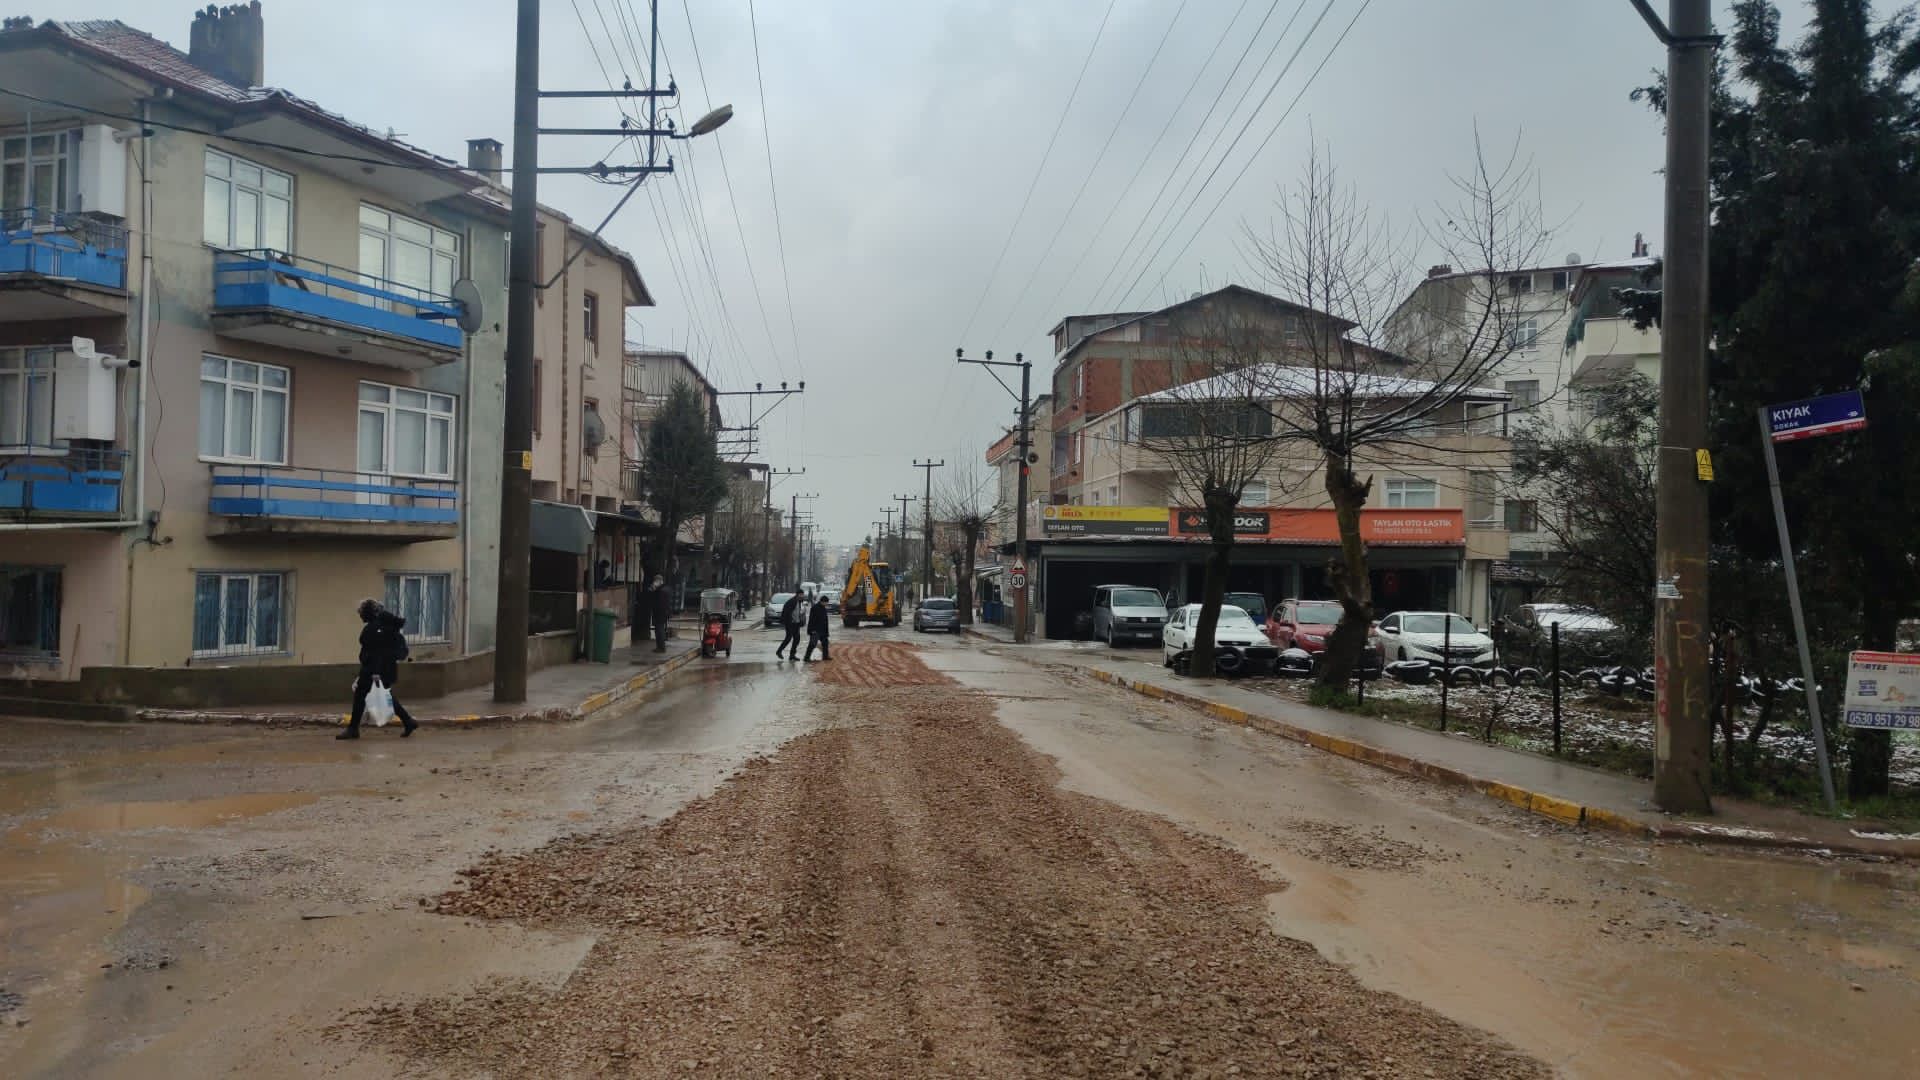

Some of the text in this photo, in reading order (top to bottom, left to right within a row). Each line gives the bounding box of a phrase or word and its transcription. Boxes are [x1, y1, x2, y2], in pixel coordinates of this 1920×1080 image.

[1773, 404, 1811, 421] KIYAK
[1373, 519, 1403, 527] TAYLAN
[1404, 519, 1421, 527] OTO
[1013, 576, 1024, 586] 30
[1849, 711, 1873, 725] 0530
[1894, 714, 1907, 727] 29
